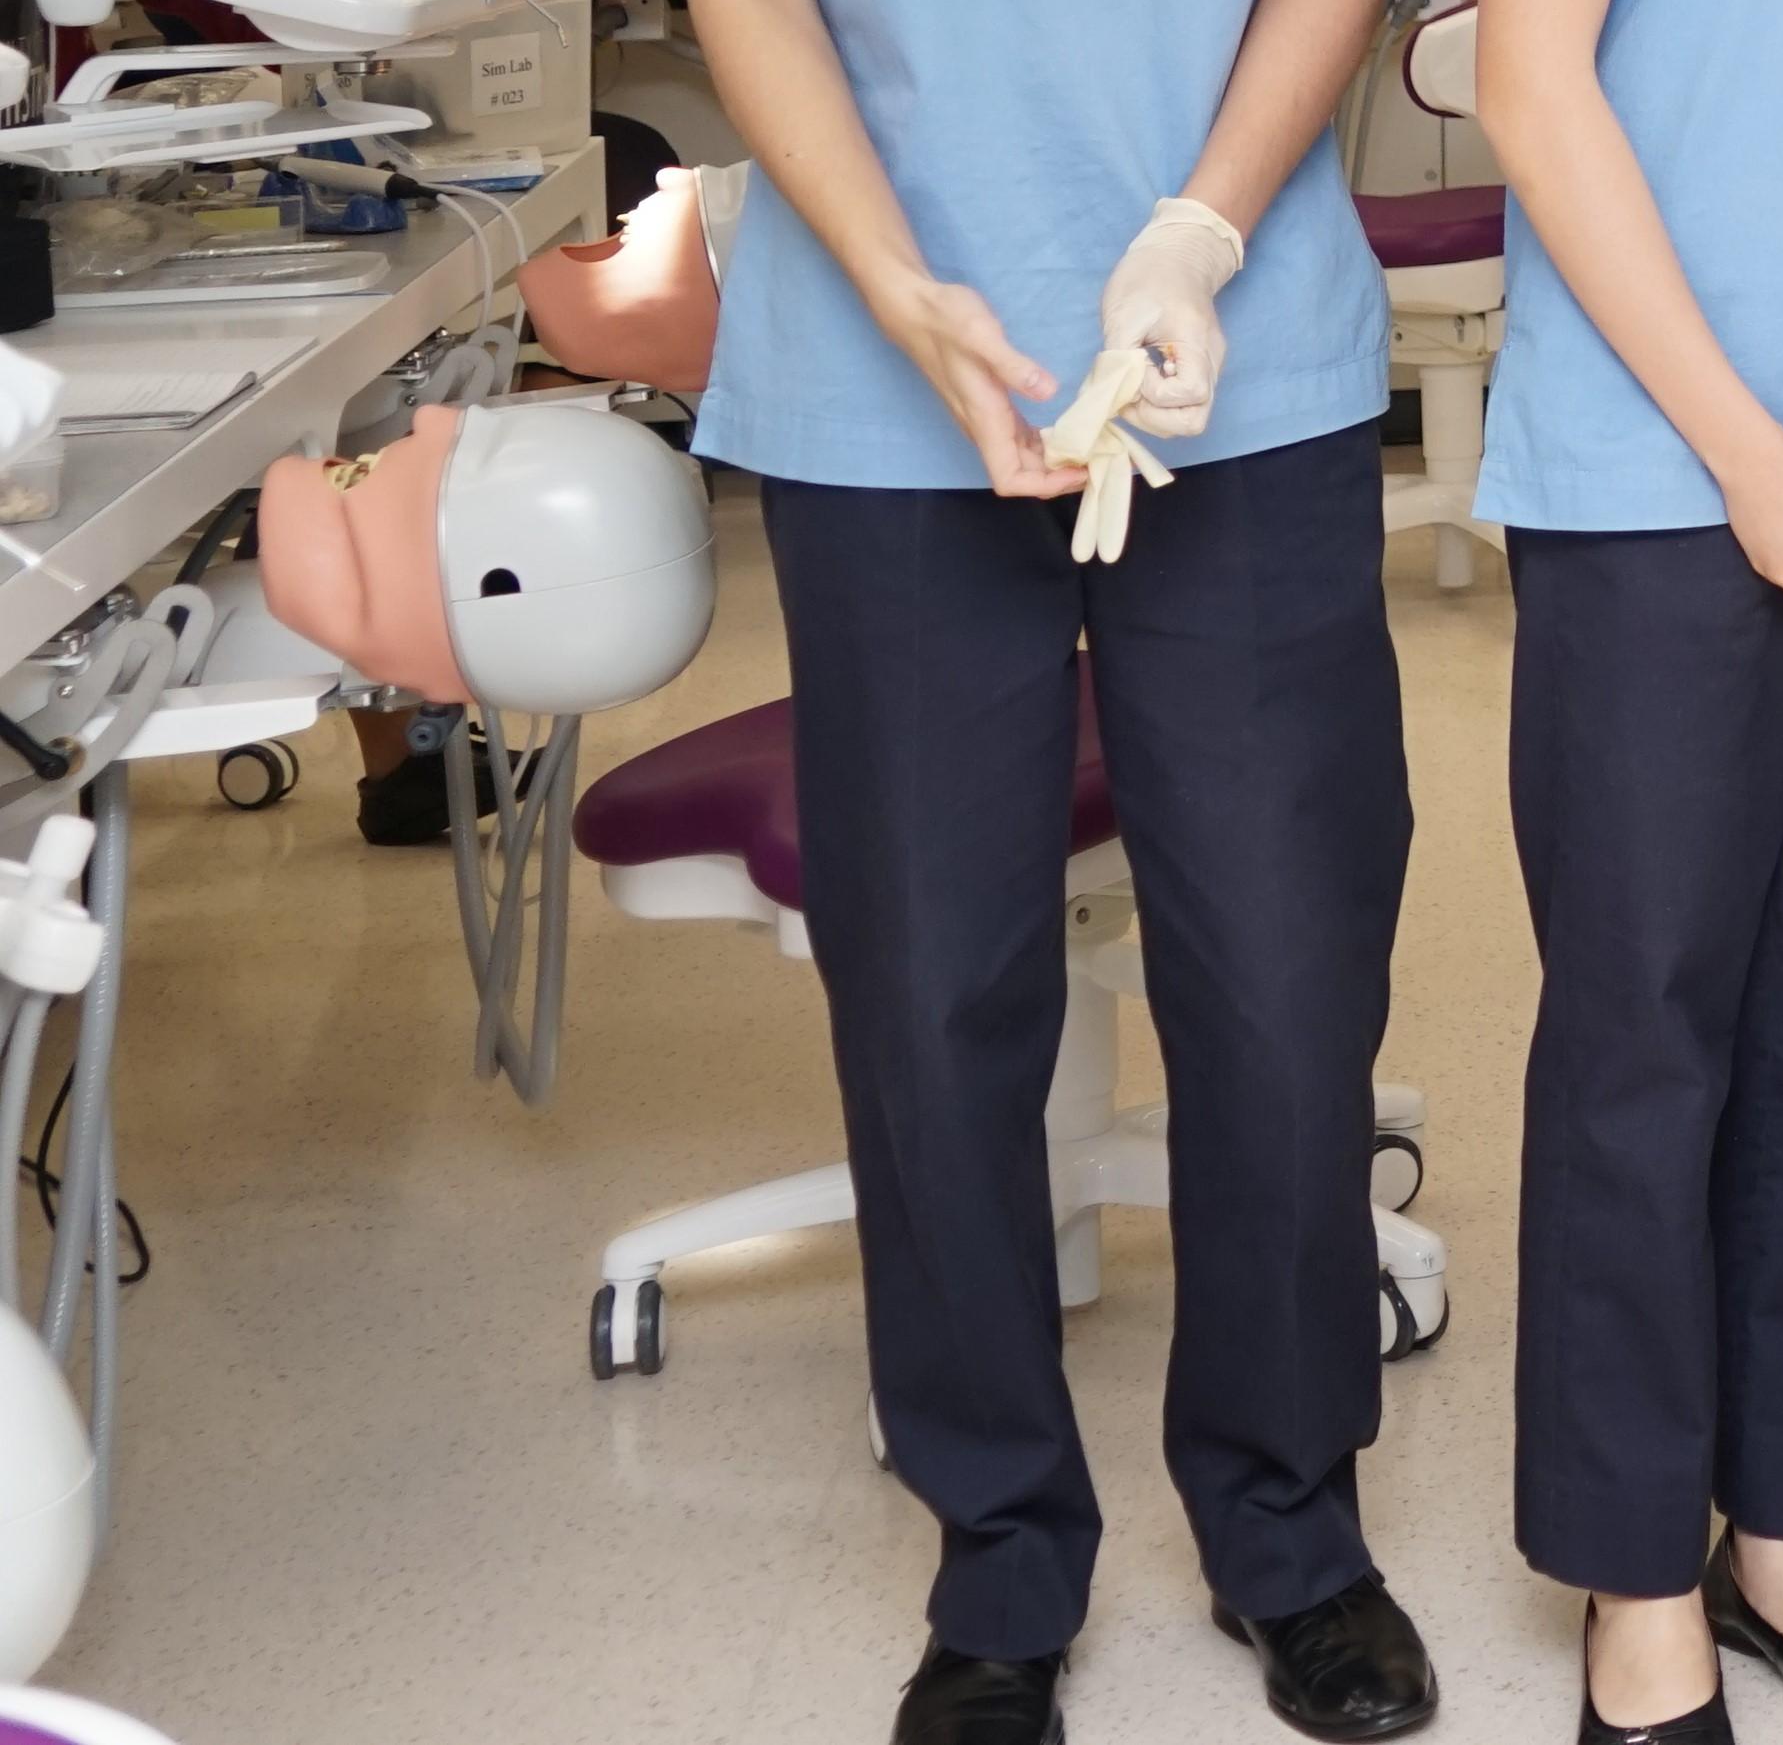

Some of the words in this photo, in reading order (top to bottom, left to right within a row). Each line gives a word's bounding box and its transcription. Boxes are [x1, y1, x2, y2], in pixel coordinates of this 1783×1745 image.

[482, 62, 506, 77] Sim
[510, 57, 532, 73] Lab
[502, 89, 524, 105] 023
